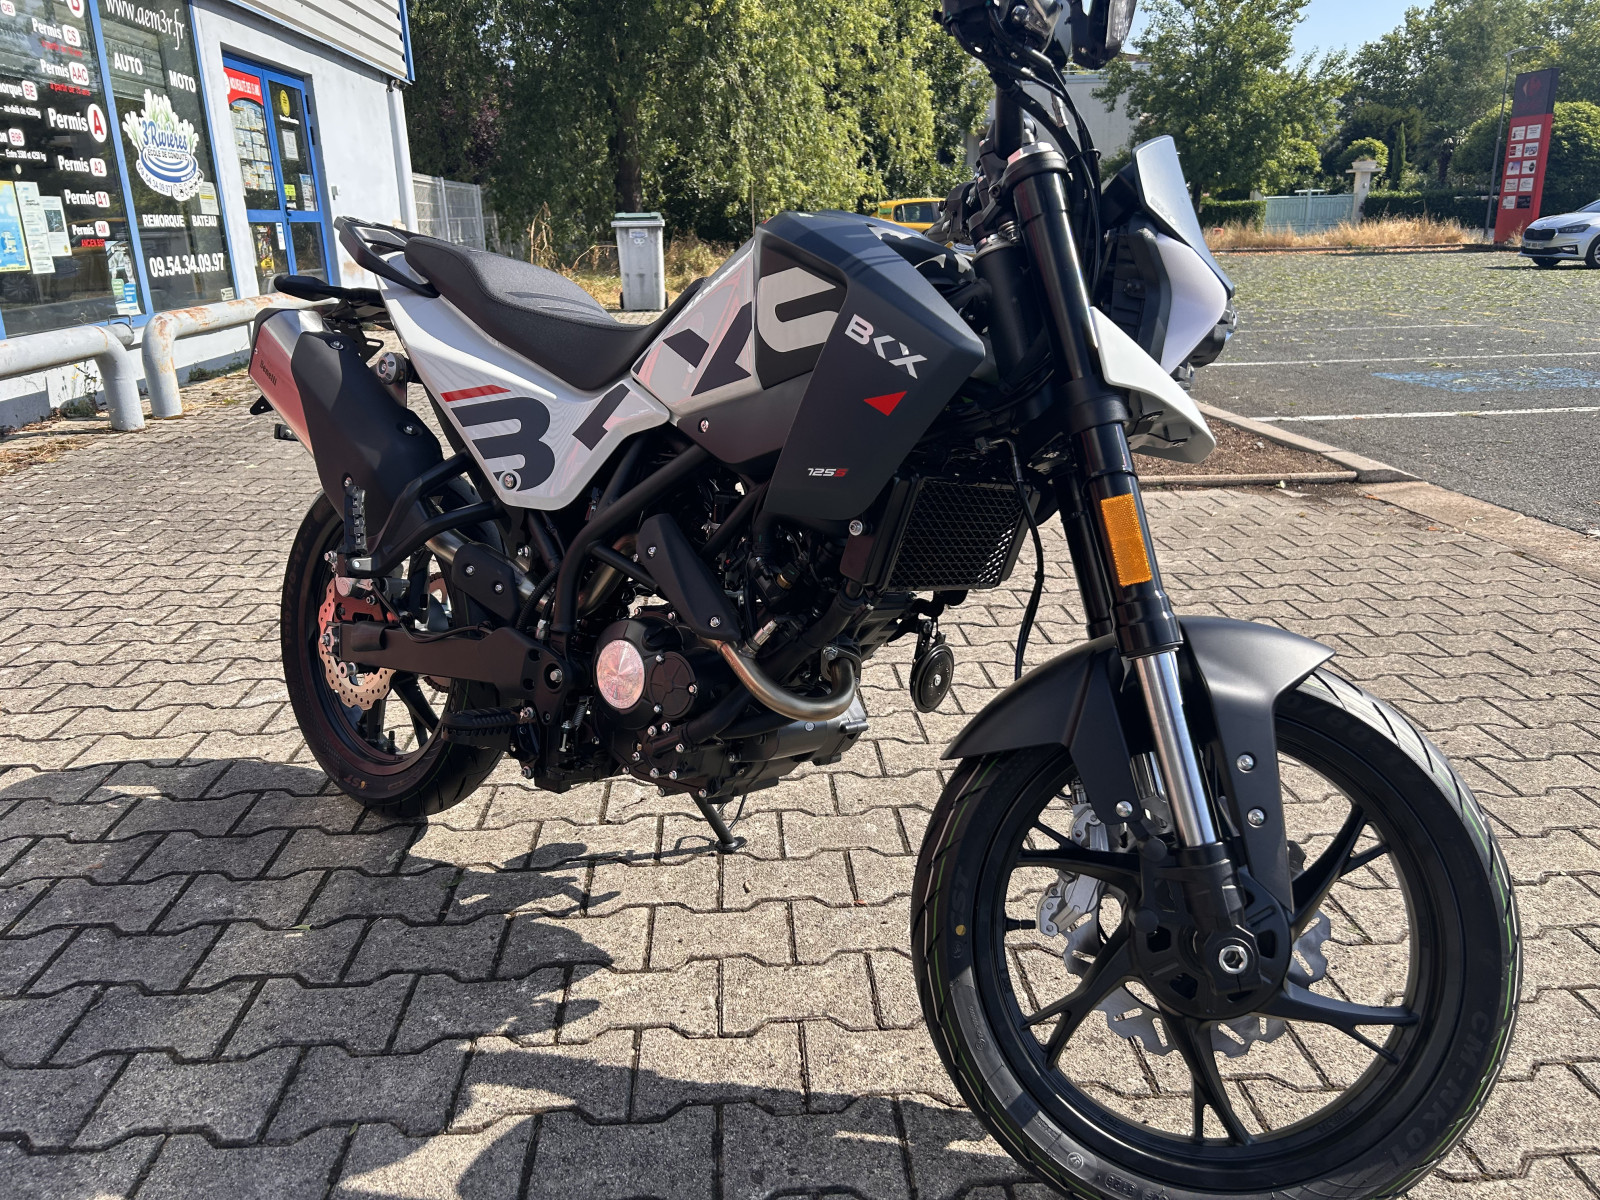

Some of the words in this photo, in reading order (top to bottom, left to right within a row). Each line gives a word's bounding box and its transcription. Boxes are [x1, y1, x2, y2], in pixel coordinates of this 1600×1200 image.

[31, 18, 62, 40] Permis
[66, 29, 77, 42] CS
[106, 0, 184, 50] www.aem3r.fr
[40, 59, 70, 78] Permis
[72, 66, 88, 82] AAC
[114, 52, 143, 76] AUTO
[24, 84, 36, 98] BE
[168, 70, 196, 92] MOTO
[48, 108, 88, 132] Permis
[93, 110, 104, 136] A
[142, 120, 148, 146] 3
[58, 155, 90, 172] Permis
[94, 162, 104, 174] A2
[64, 189, 96, 205] Permis
[97, 193, 108, 206] A1
[72, 224, 95, 236] Permis
[142, 214, 186, 228] REMORQUE
[192, 215, 218, 226] BATEAU
[82, 239, 97, 248] ANCIEN
[149, 252, 224, 278] 09.54.34.09.97
[844, 313, 928, 380] BKX
[260, 359, 277, 386] Benelli
[808, 467, 848, 478] 125S
